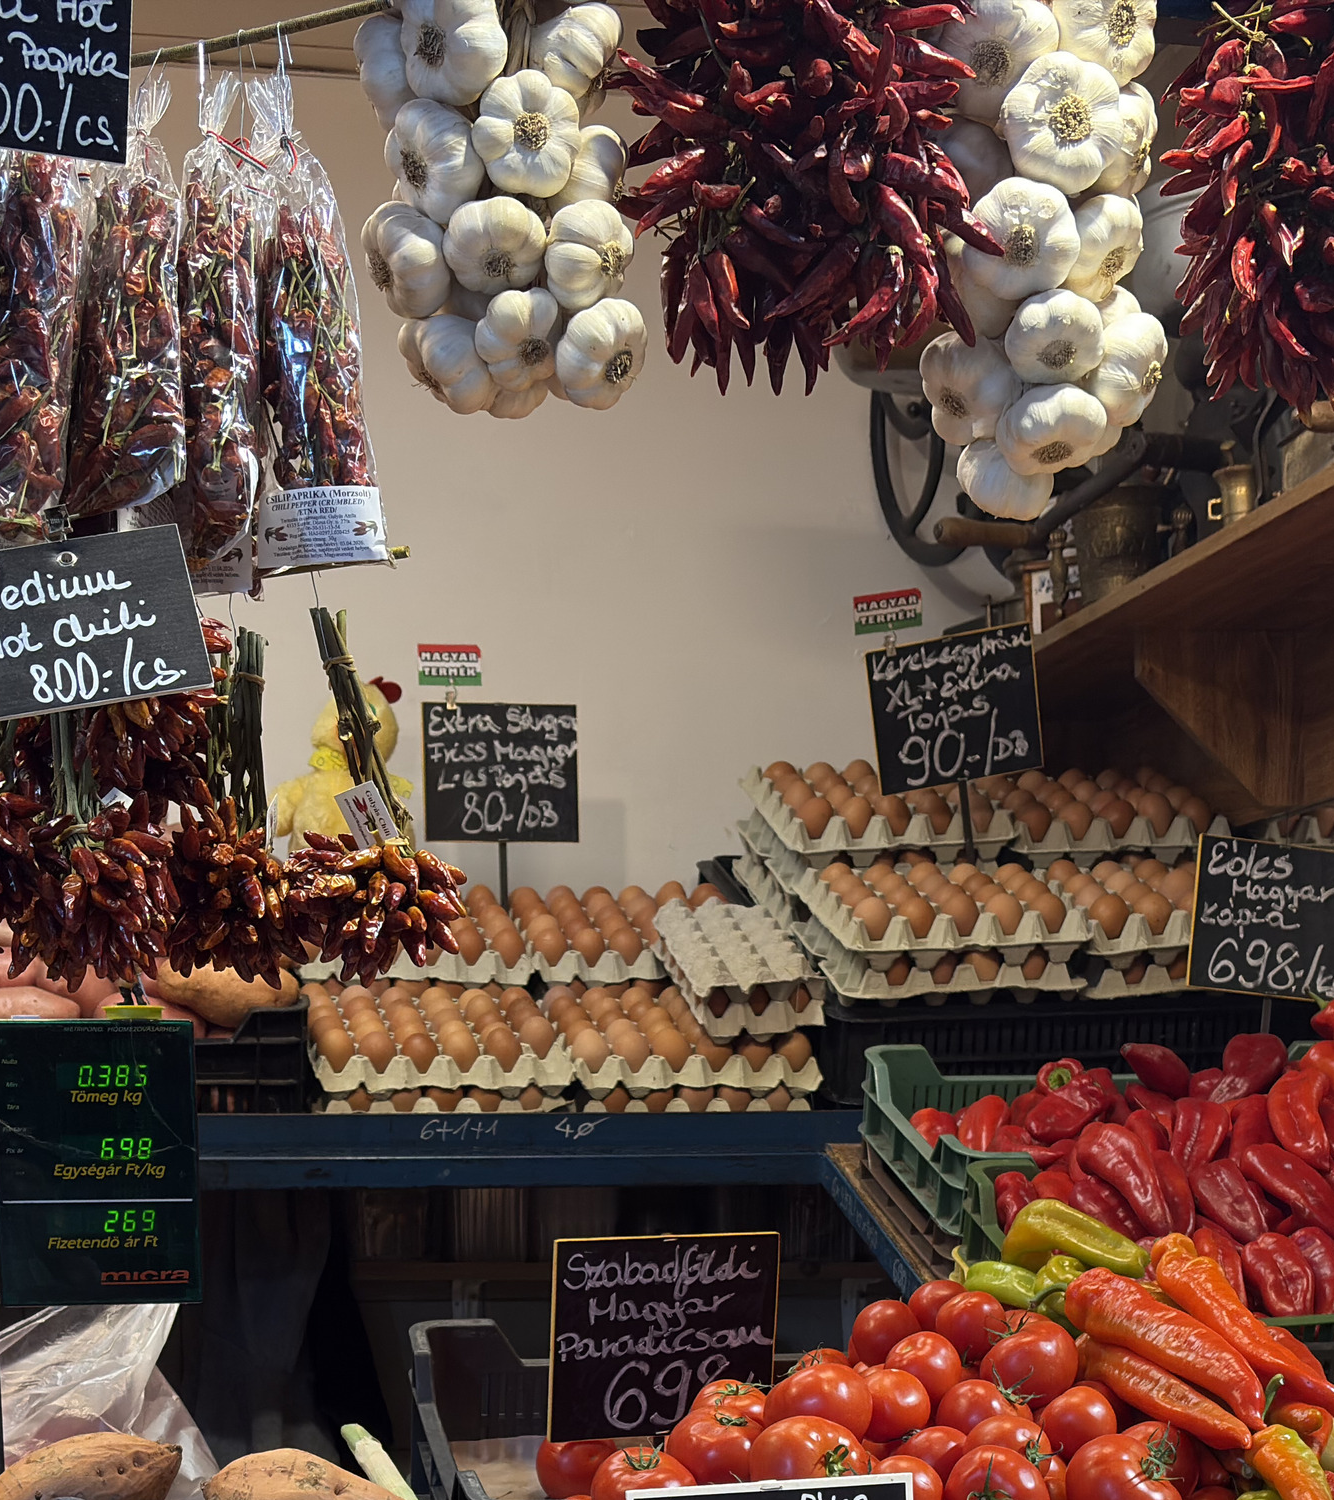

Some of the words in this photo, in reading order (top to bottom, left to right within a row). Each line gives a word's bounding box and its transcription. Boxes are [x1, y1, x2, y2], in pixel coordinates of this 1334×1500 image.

[266, 491, 327, 504] CSILIPAPRIKA
[272, 503, 290, 511] CHILI
[291, 501, 317, 509] PEPPER
[318, 498, 365, 507] (CRUMBLED)
[857, 594, 919, 613] MAGYAR
[54, 600, 157, 648] Chili
[859, 609, 917, 625] TERMÉK
[420, 652, 478, 662] MAGYAR
[423, 664, 477, 677] TERMÉK
[428, 706, 502, 734] Extra
[493, 740, 578, 771] Magyar
[78, 1064, 147, 1087] 0.385
[70, 1090, 118, 1106] Tömeg
[123, 1090, 143, 1105] kg
[100, 1138, 153, 1160] 698
[53, 1163, 122, 1180] Egységár
[125, 1162, 166, 1178] Ft/kg
[104, 1209, 156, 1233] 269
[124, 1236, 141, 1248] ár
[144, 1235, 158, 1248] Ft
[101, 1269, 190, 1282] micra
[589, 1293, 735, 1336] Magyar
